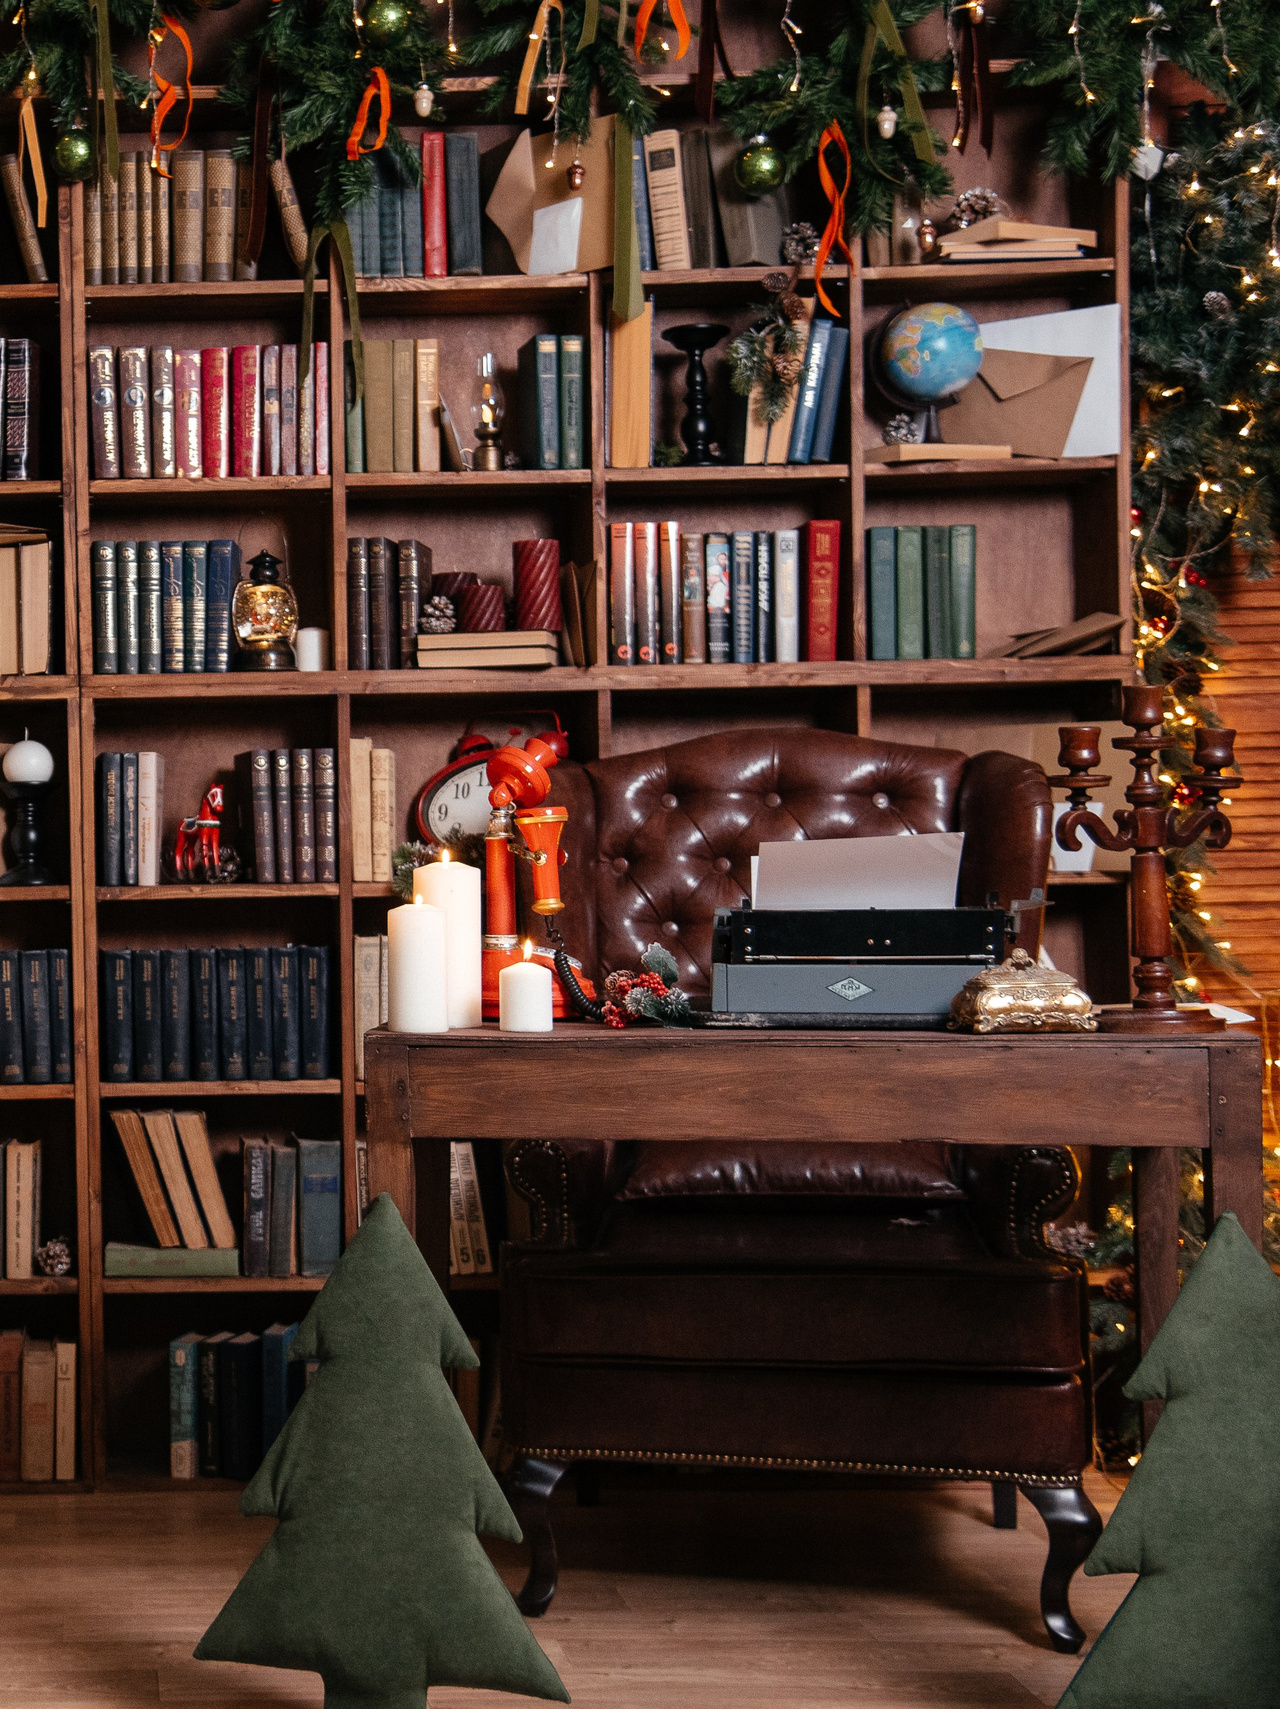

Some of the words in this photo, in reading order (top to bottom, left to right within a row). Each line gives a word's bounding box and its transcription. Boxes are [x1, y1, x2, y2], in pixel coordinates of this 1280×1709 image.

[453, 782, 470, 799] 10
[437, 803, 448, 822] 9
[460, 1246, 470, 1263] 5
[475, 1248, 487, 1265] 6
